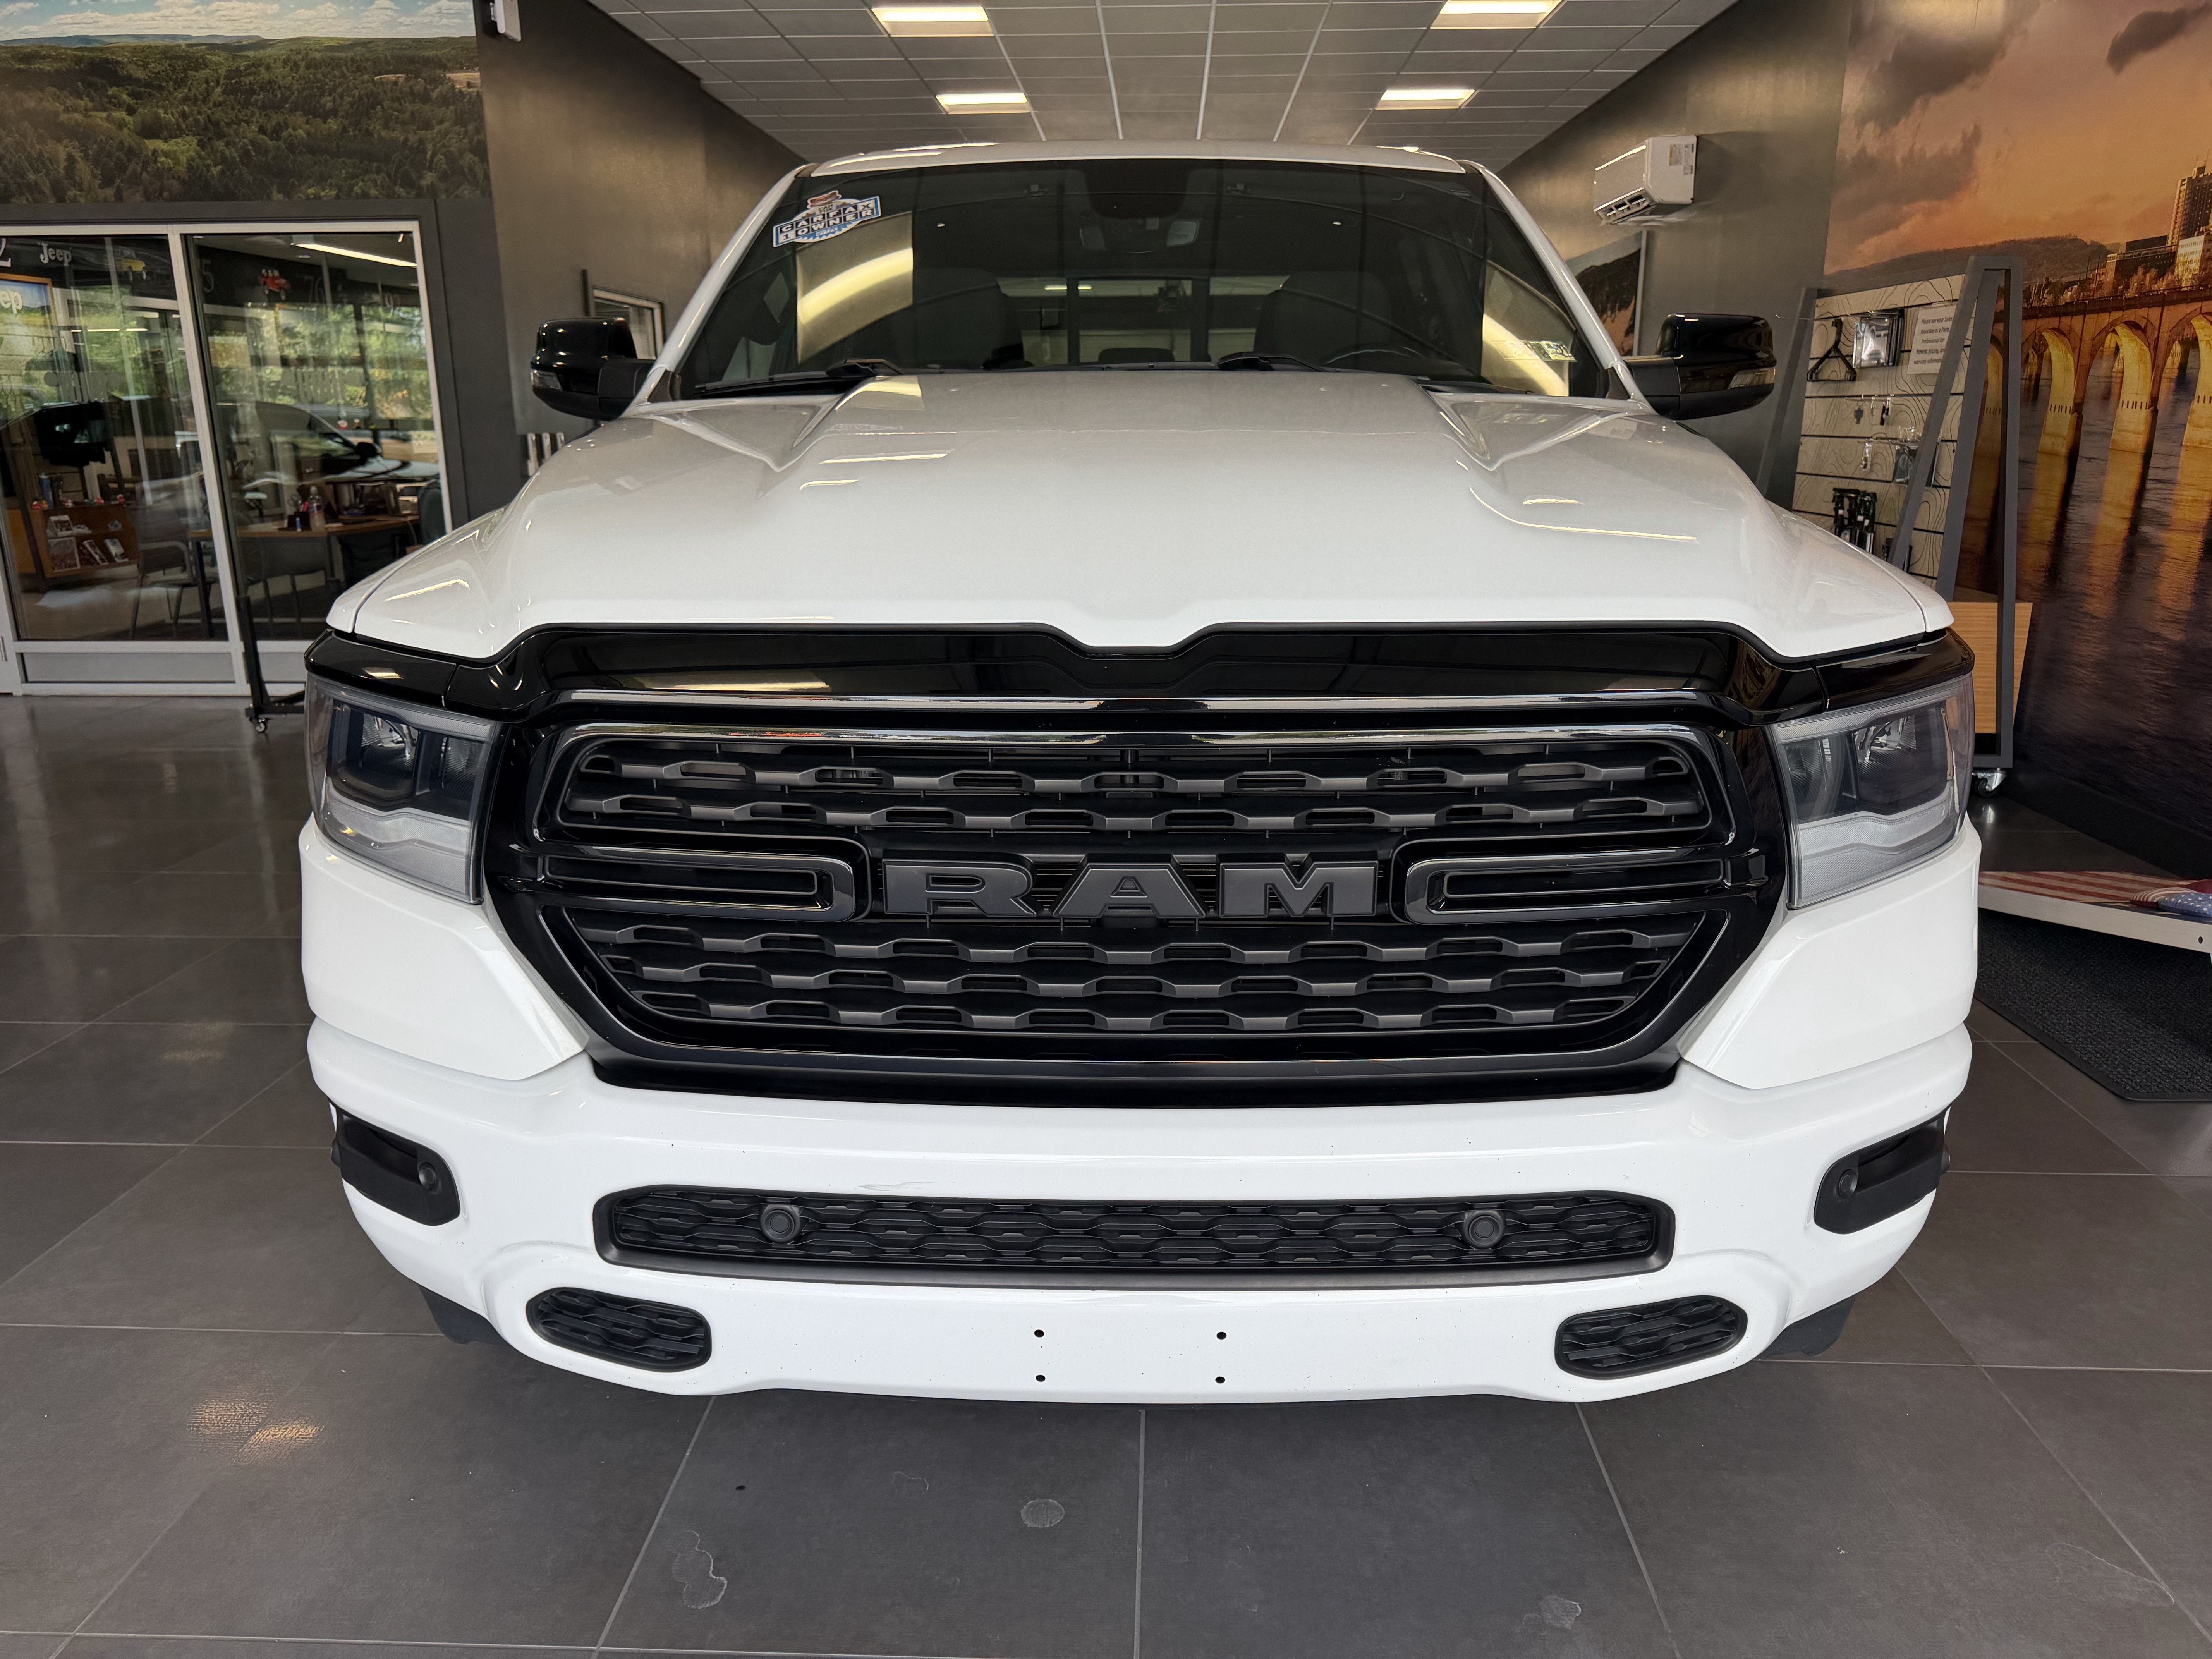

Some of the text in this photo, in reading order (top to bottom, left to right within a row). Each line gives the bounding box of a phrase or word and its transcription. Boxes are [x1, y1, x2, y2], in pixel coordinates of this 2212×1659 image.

[781, 203, 871, 232] CARFAX
[797, 210, 872, 235] OWNER
[38, 242, 72, 266] Jeep
[0, 291, 23, 314] ep
[884, 858, 1379, 919] RAM
